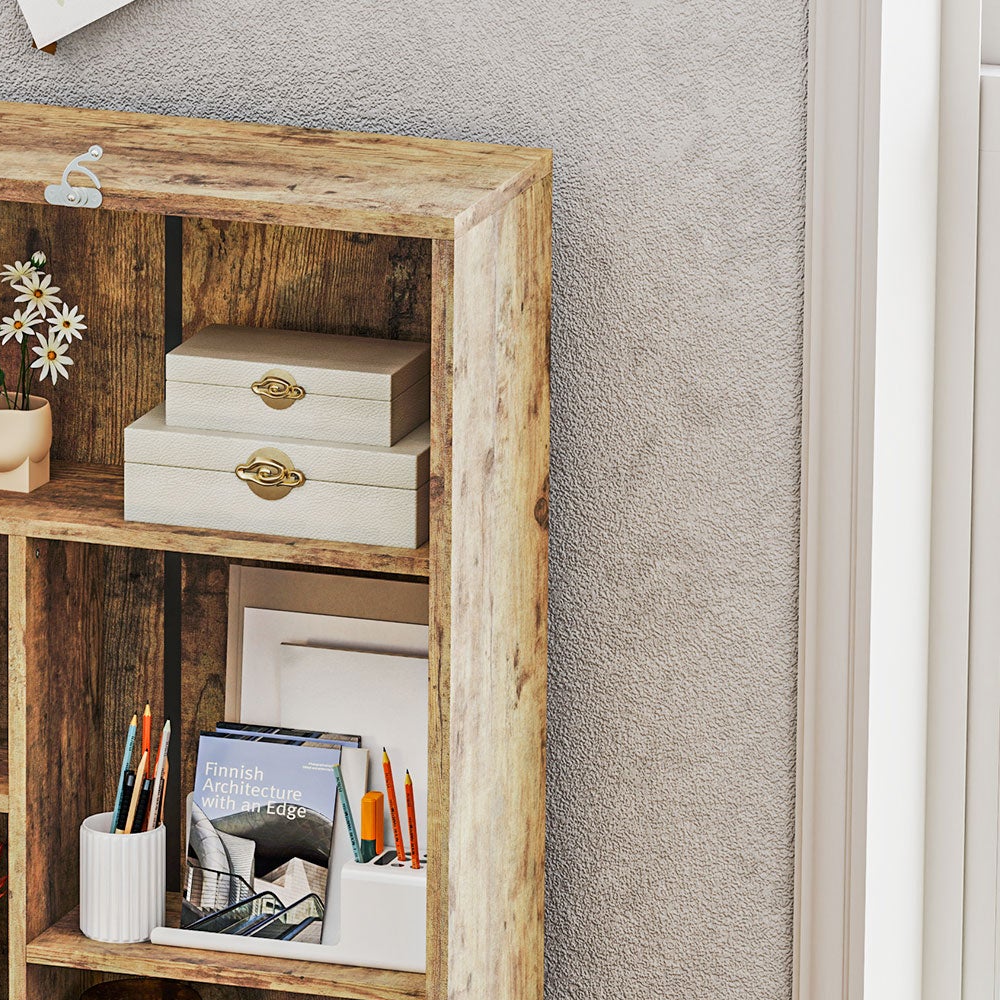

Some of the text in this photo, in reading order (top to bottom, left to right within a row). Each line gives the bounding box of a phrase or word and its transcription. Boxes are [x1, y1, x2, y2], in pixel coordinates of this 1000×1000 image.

[205, 762, 264, 781] Finnish
[202, 778, 302, 801] Architecture
[201, 795, 307, 820] with an Edge
